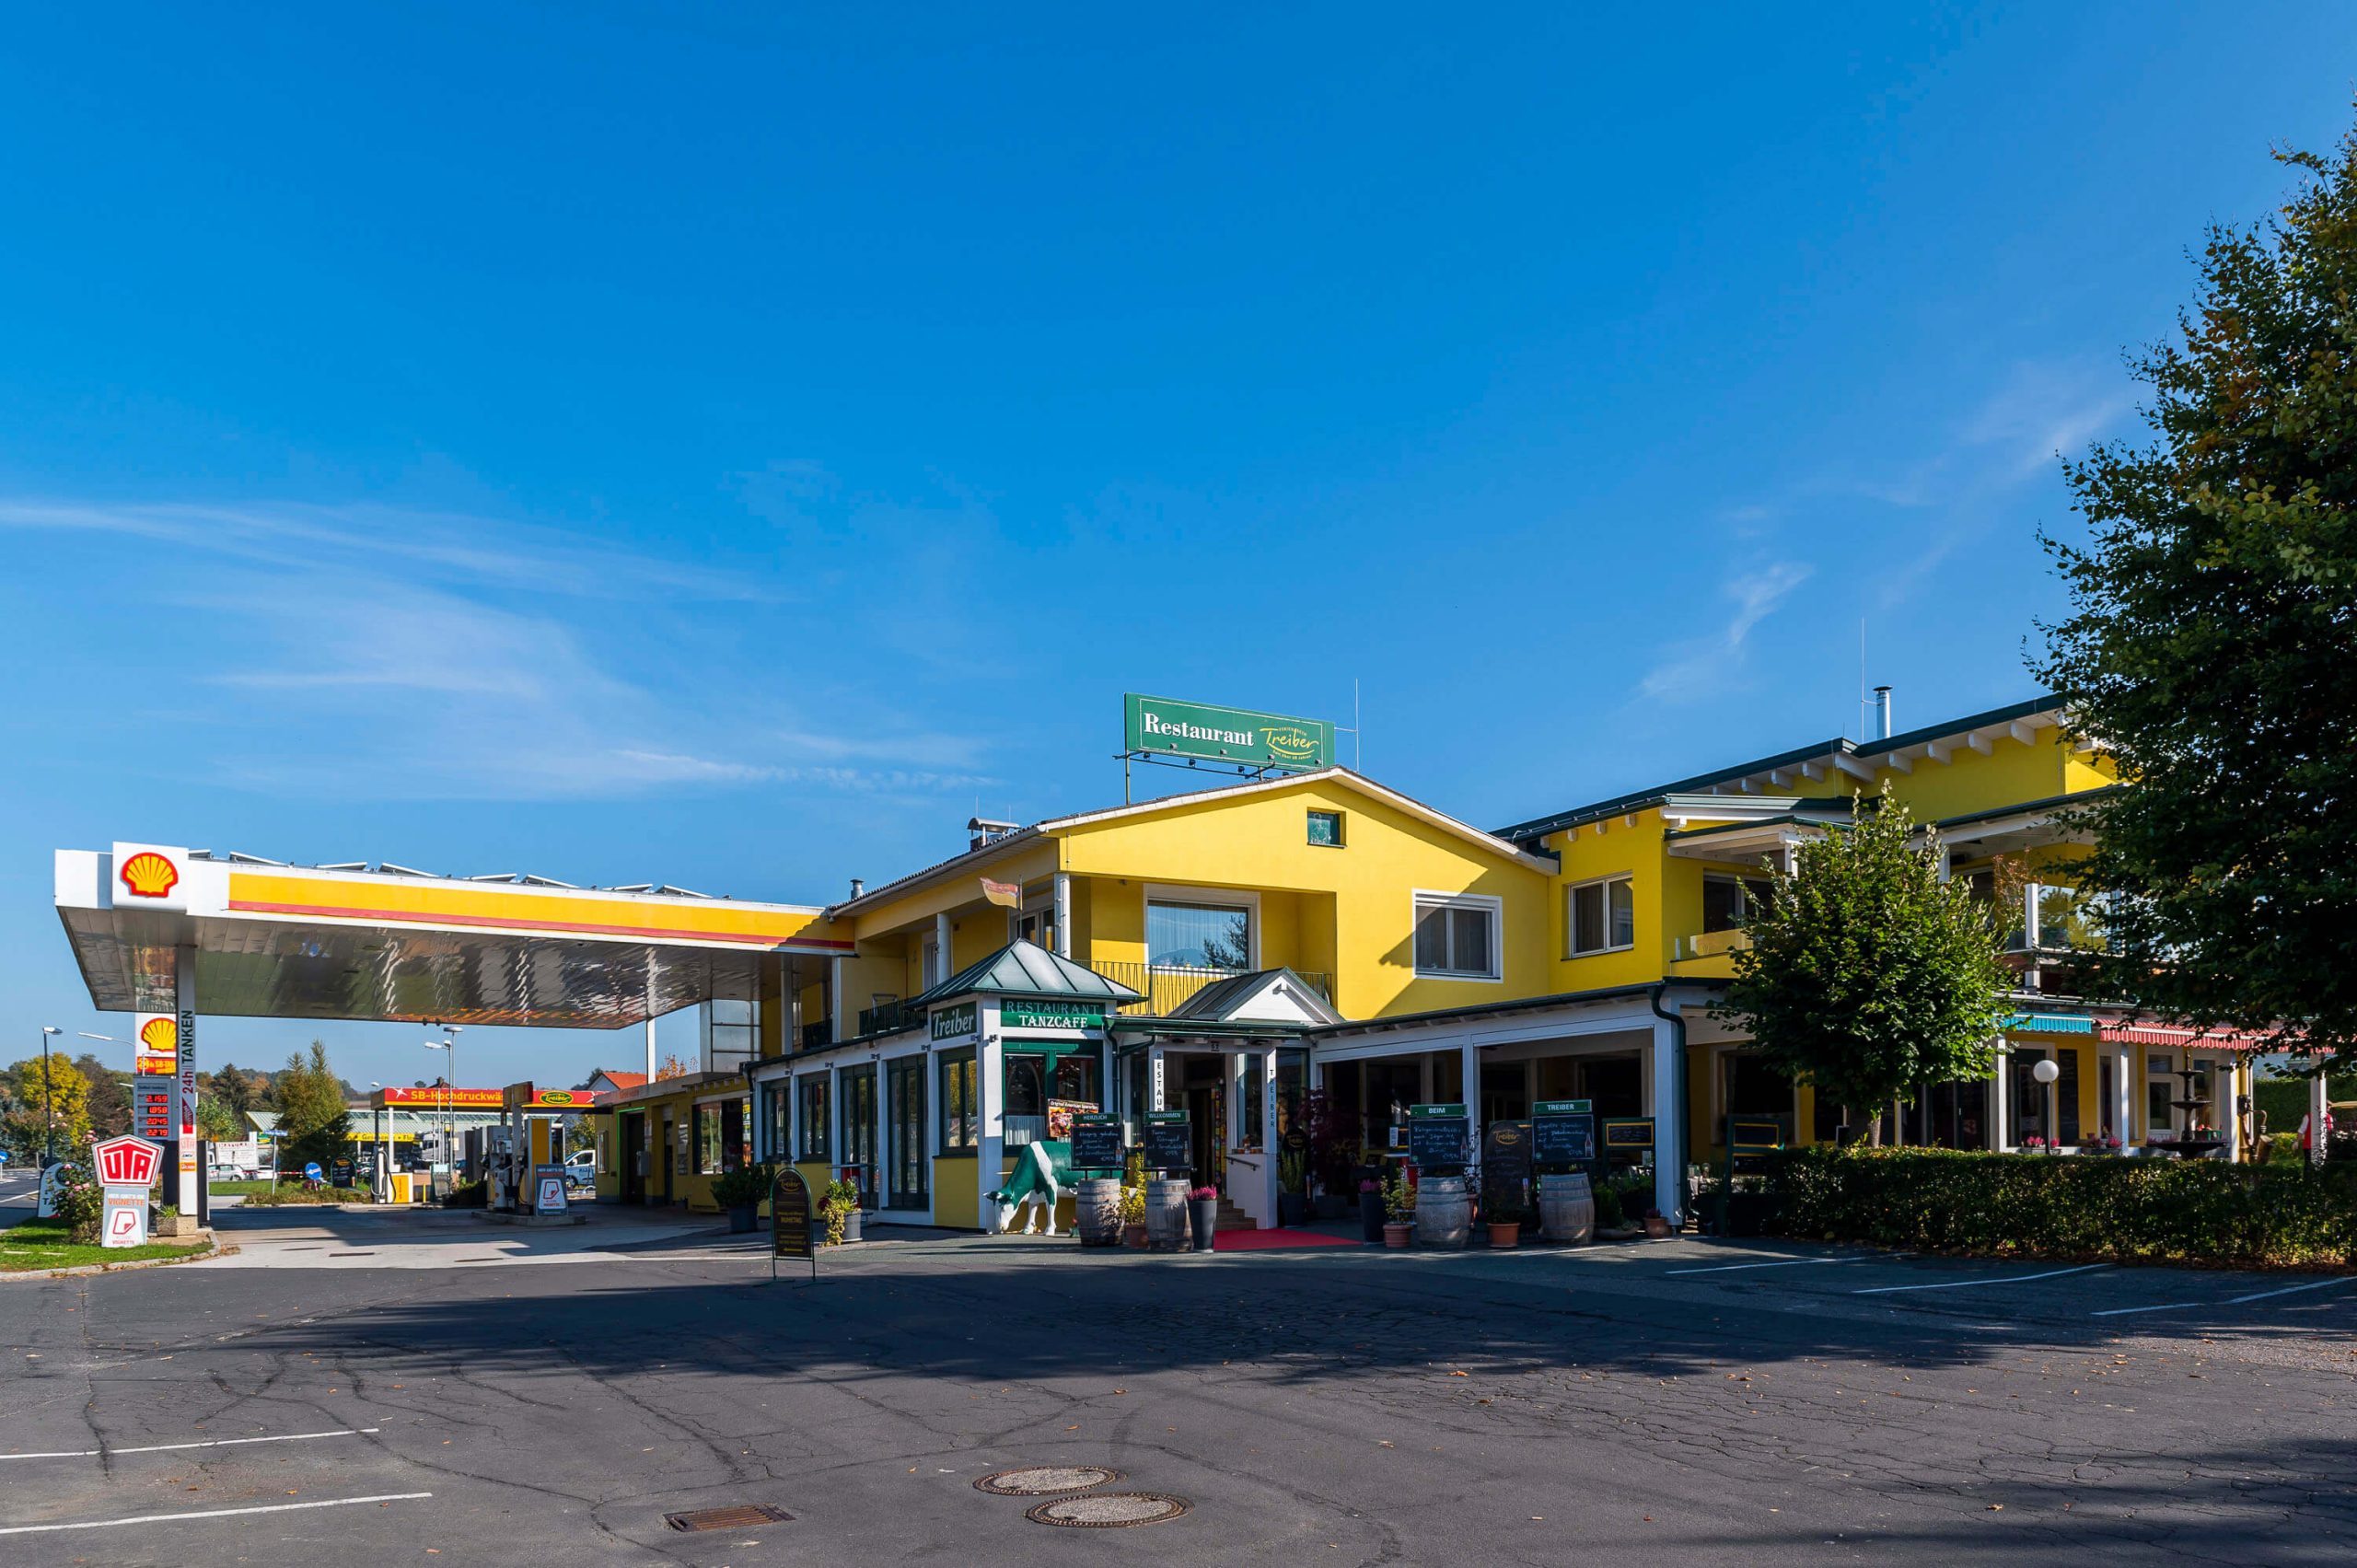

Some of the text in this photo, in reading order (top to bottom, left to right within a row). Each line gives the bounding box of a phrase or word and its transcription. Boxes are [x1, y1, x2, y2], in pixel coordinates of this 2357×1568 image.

[1144, 713, 1255, 747] Restaurant
[1260, 727, 1319, 750] Treiber
[1006, 1001, 1100, 1016] RESTAURANT
[932, 1007, 974, 1037] Treiber
[1018, 1015, 1088, 1028] TANZCAFE
[181, 1010, 193, 1064] TANKEN
[182, 1071, 193, 1094] 24h
[1547, 1103, 1574, 1111] TREIBER
[102, 1144, 154, 1179] UTA
[108, 1198, 145, 1206] VIGNETTE
